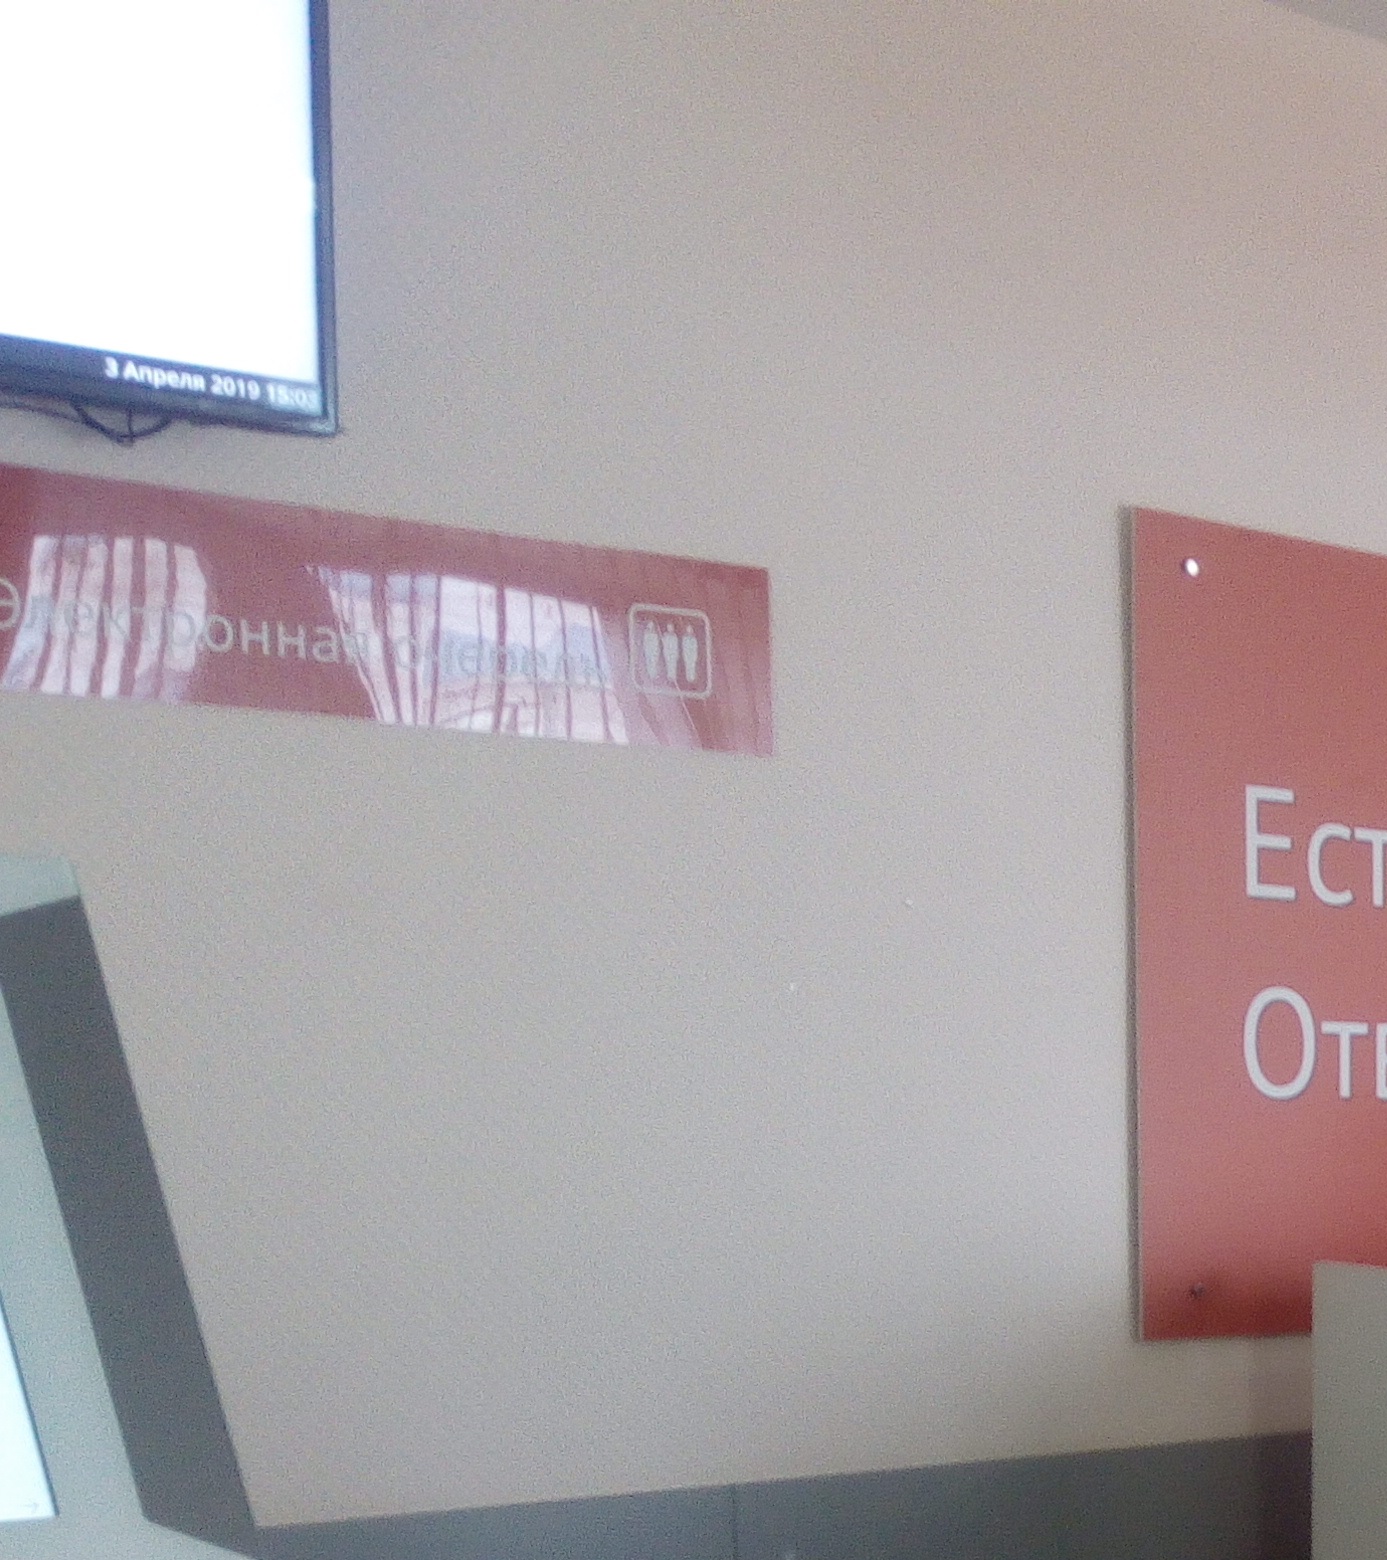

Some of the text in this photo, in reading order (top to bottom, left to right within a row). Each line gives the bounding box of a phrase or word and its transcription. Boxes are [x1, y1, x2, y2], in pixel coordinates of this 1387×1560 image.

[104, 357, 118, 378] 3
[124, 360, 205, 390] Апреля
[210, 374, 260, 400] 2019
